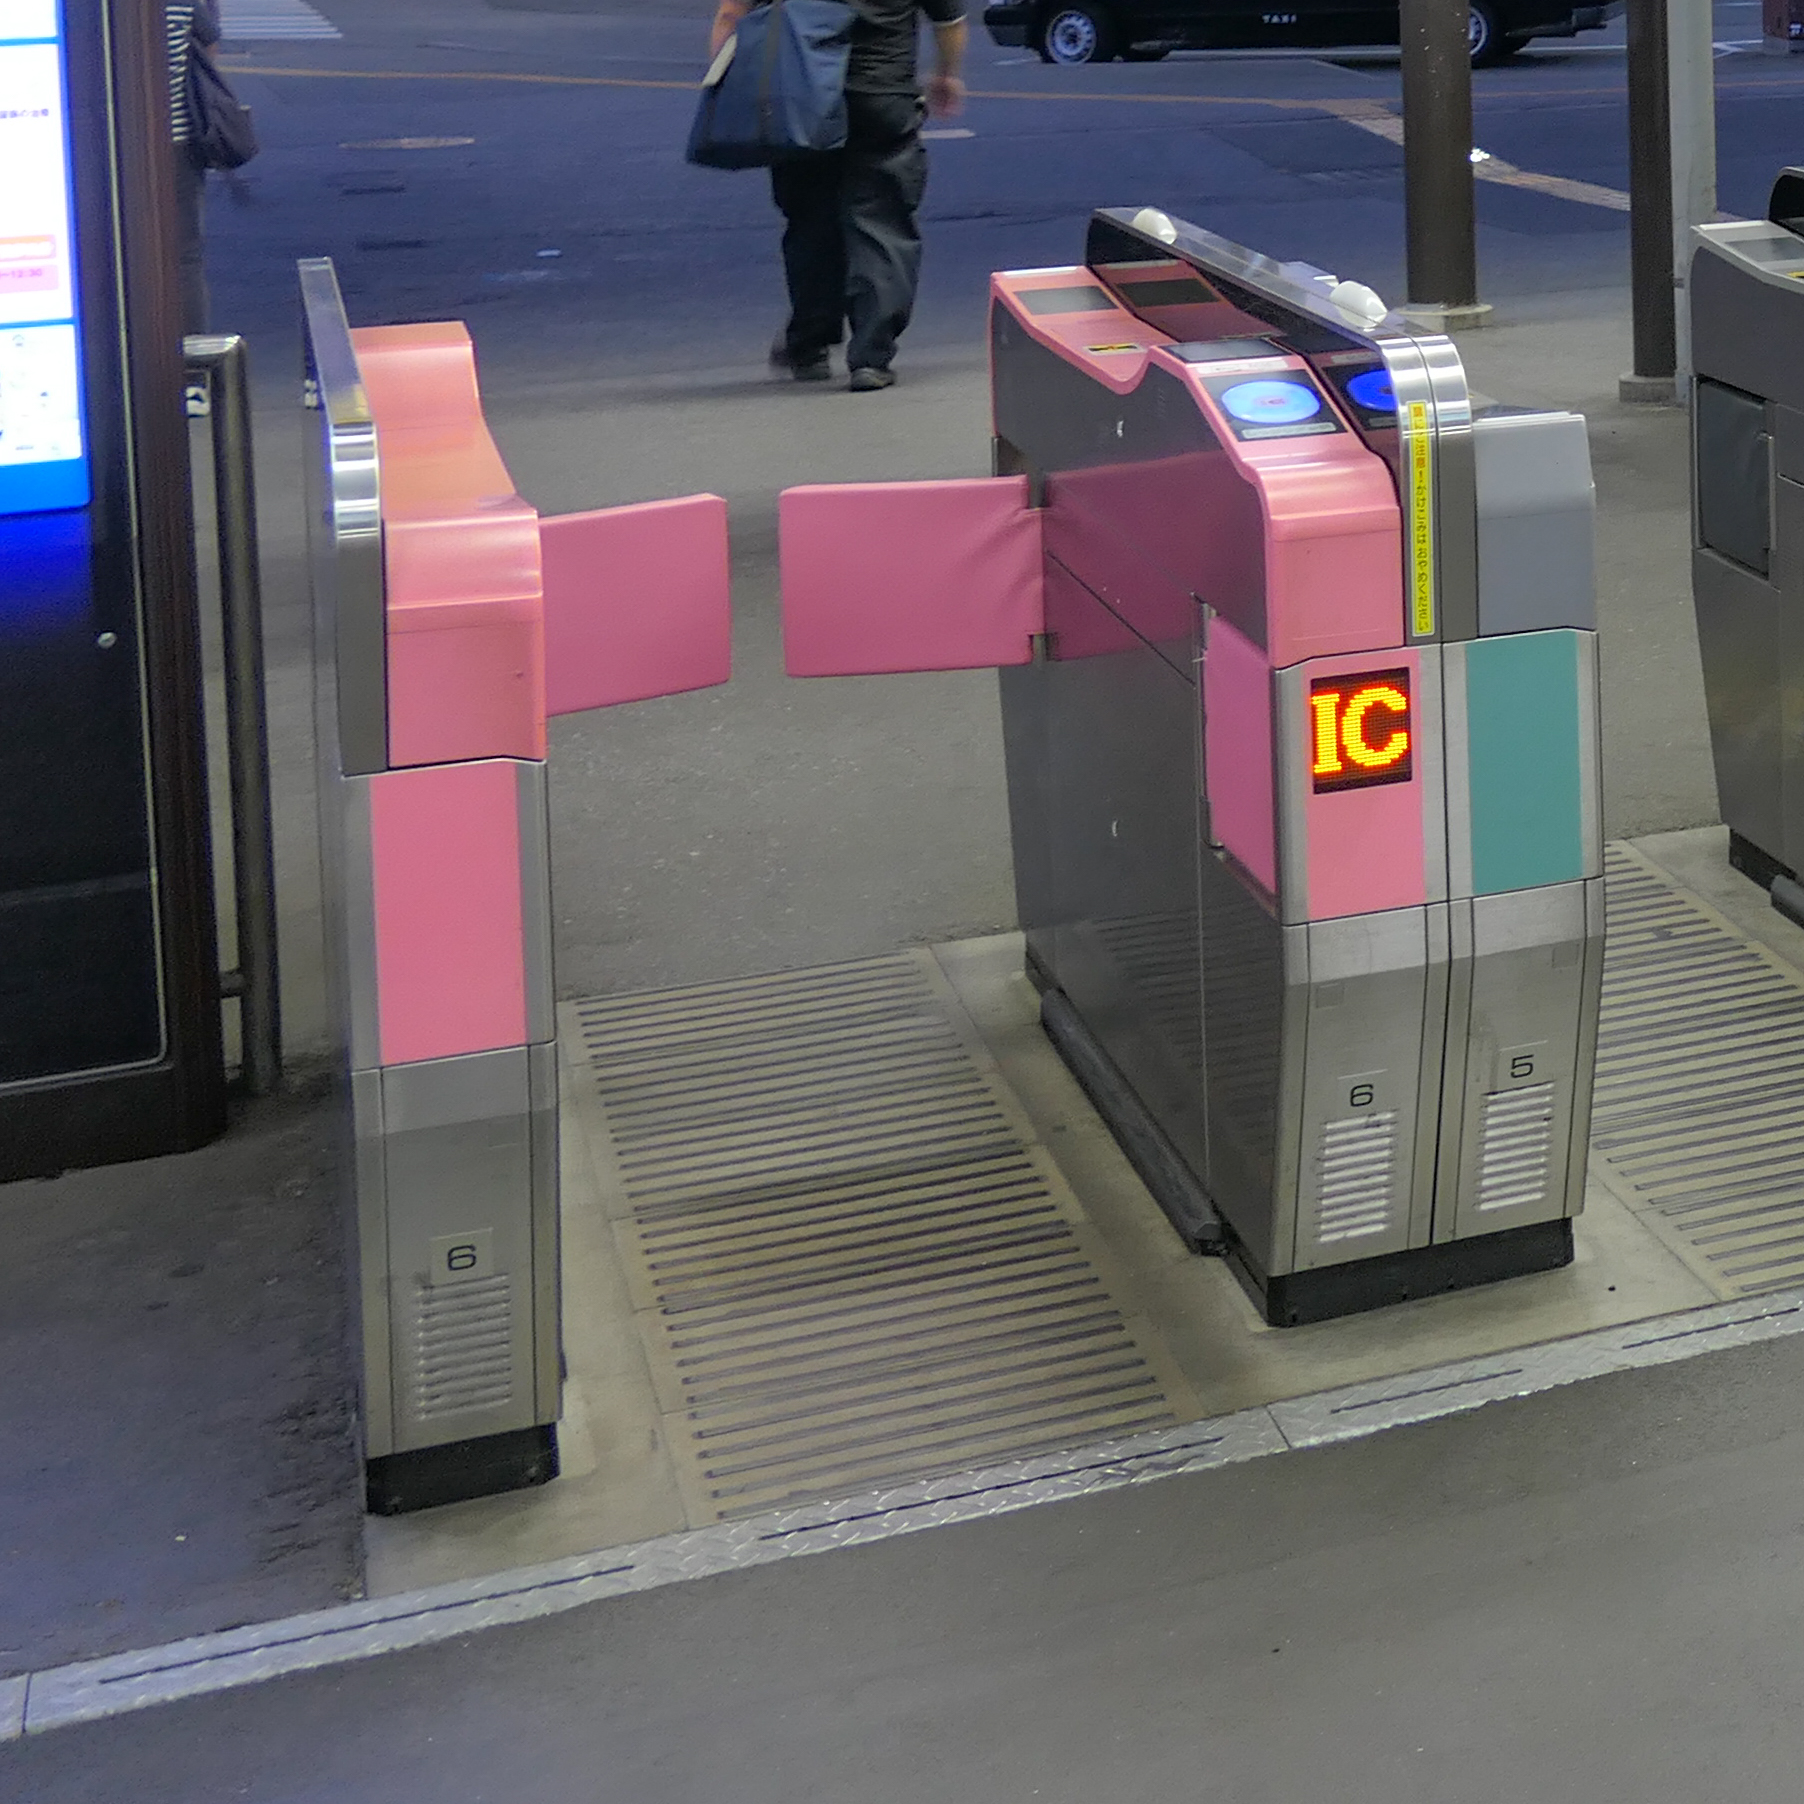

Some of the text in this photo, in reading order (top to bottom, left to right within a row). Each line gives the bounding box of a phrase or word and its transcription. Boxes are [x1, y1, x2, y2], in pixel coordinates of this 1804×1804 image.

[1313, 685, 1410, 777] IC
[1509, 1054, 1534, 1079] 5
[1350, 1082, 1375, 1108] 6
[447, 1243, 480, 1271] 6
